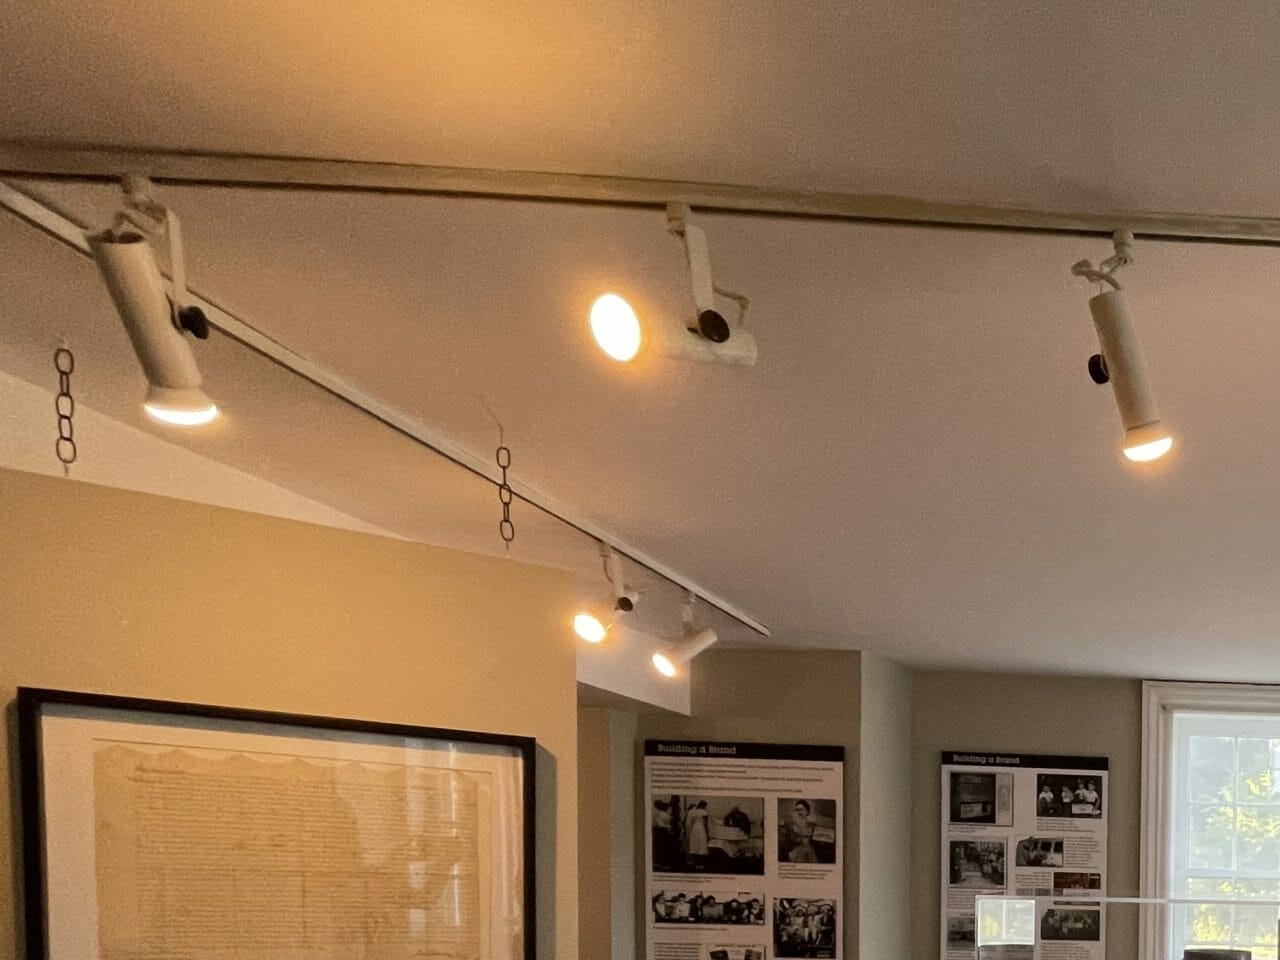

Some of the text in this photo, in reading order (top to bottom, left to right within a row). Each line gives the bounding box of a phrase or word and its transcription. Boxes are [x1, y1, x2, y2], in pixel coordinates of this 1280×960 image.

[657, 743, 737, 755] Building a Brand
